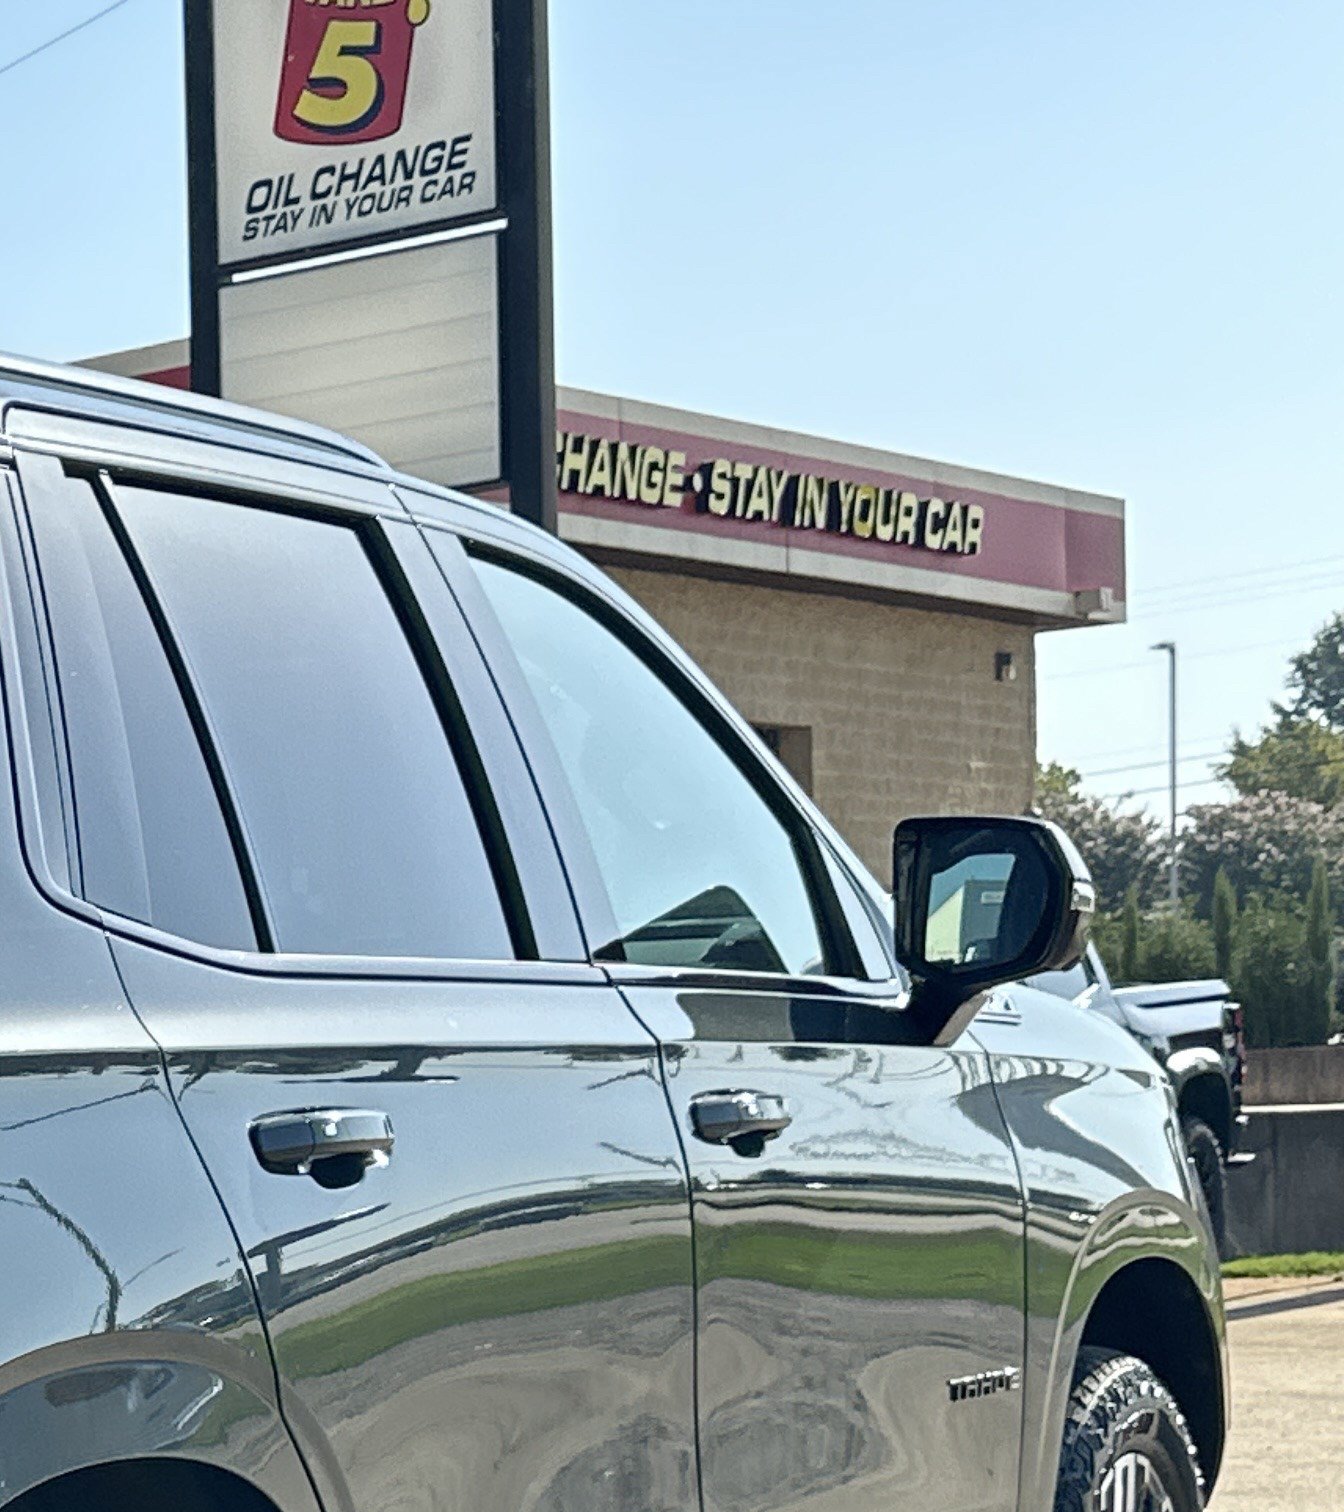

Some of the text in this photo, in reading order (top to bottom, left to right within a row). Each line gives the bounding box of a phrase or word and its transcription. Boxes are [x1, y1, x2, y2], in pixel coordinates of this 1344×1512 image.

[292, 19, 385, 135] 5
[242, 171, 476, 242] STAY IN YOUR CAR
[245, 134, 473, 215] OIL CHANGE
[707, 457, 789, 523] STAY
[794, 474, 827, 529] IN
[836, 481, 920, 543] YOUR
[923, 499, 986, 555] CAR
